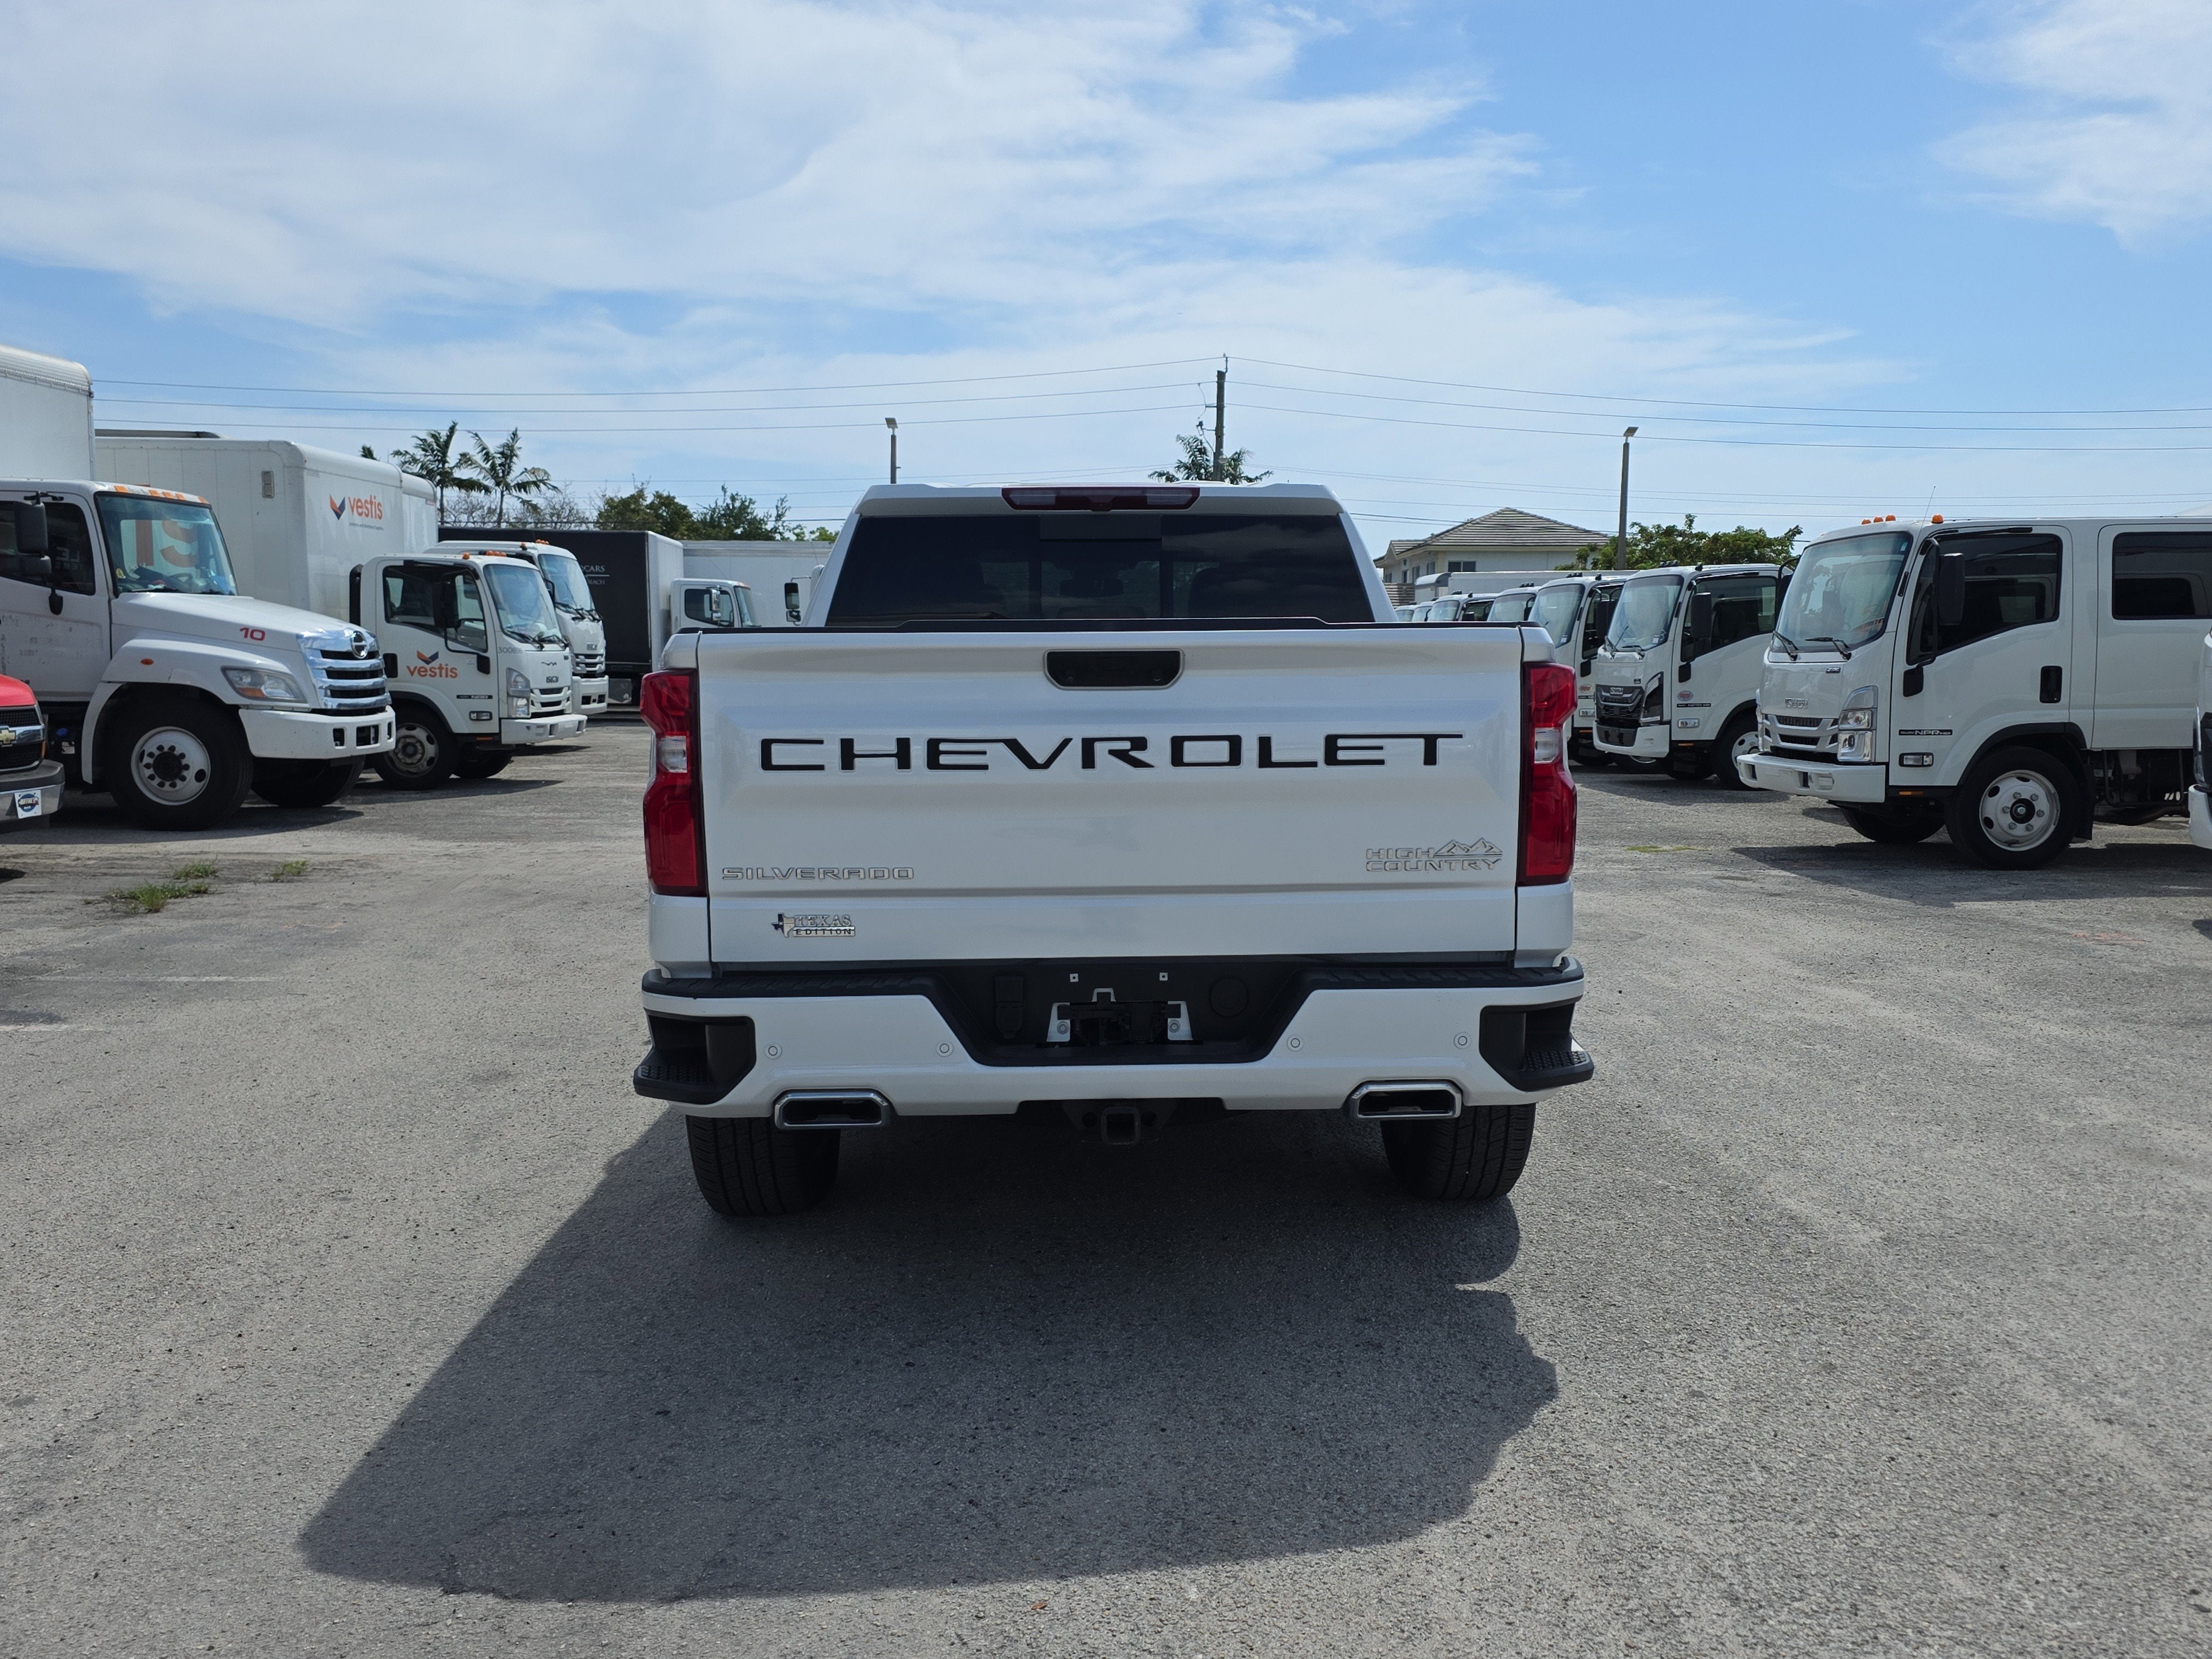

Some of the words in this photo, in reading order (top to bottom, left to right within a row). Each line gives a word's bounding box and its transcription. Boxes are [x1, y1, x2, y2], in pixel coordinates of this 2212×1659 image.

[348, 494, 383, 520] vestis
[240, 627, 266, 641] 10
[407, 663, 458, 678] vestis
[761, 733, 1463, 771] CHEVROLET
[1366, 847, 1435, 860] HIGH
[1366, 858, 1502, 872] COUNTRY
[722, 867, 914, 880] SILVERADO
[794, 914, 852, 927] TEXAS
